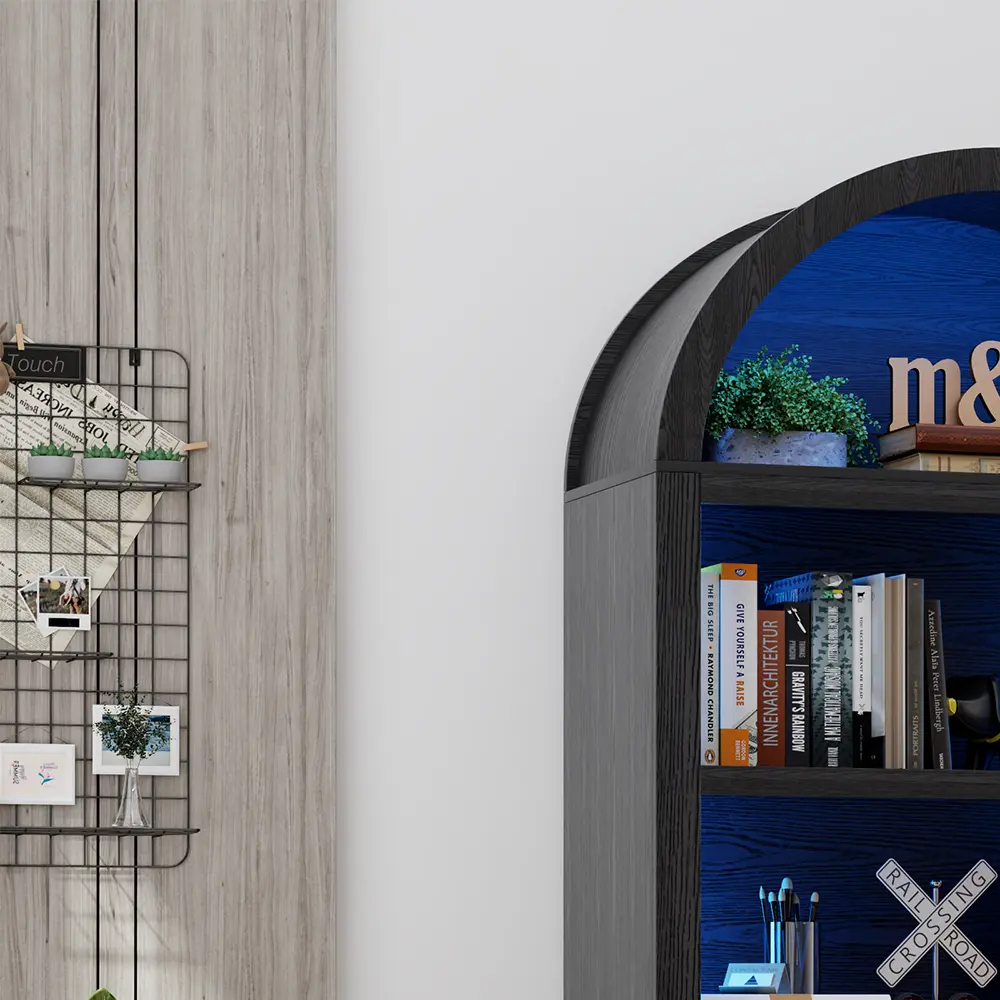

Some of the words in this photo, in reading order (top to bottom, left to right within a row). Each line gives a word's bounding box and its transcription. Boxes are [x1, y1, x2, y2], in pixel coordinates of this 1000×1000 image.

[8, 354, 65, 373] Touch
[736, 603, 745, 623] GIVE
[736, 626, 745, 669] YOURSELF
[736, 681, 745, 706] RAISE
[763, 620, 779, 747] INNENARCHITEKTUR
[824, 666, 841, 690] MOSAIC
[824, 690, 841, 736] MATHEMATICAL
[933, 694, 945, 733] Lindbergh
[792, 714, 805, 752] RAINBOW
[886, 867, 921, 914] RAIL
[943, 929, 990, 978] ROAD
[888, 870, 987, 975] CROSSING
